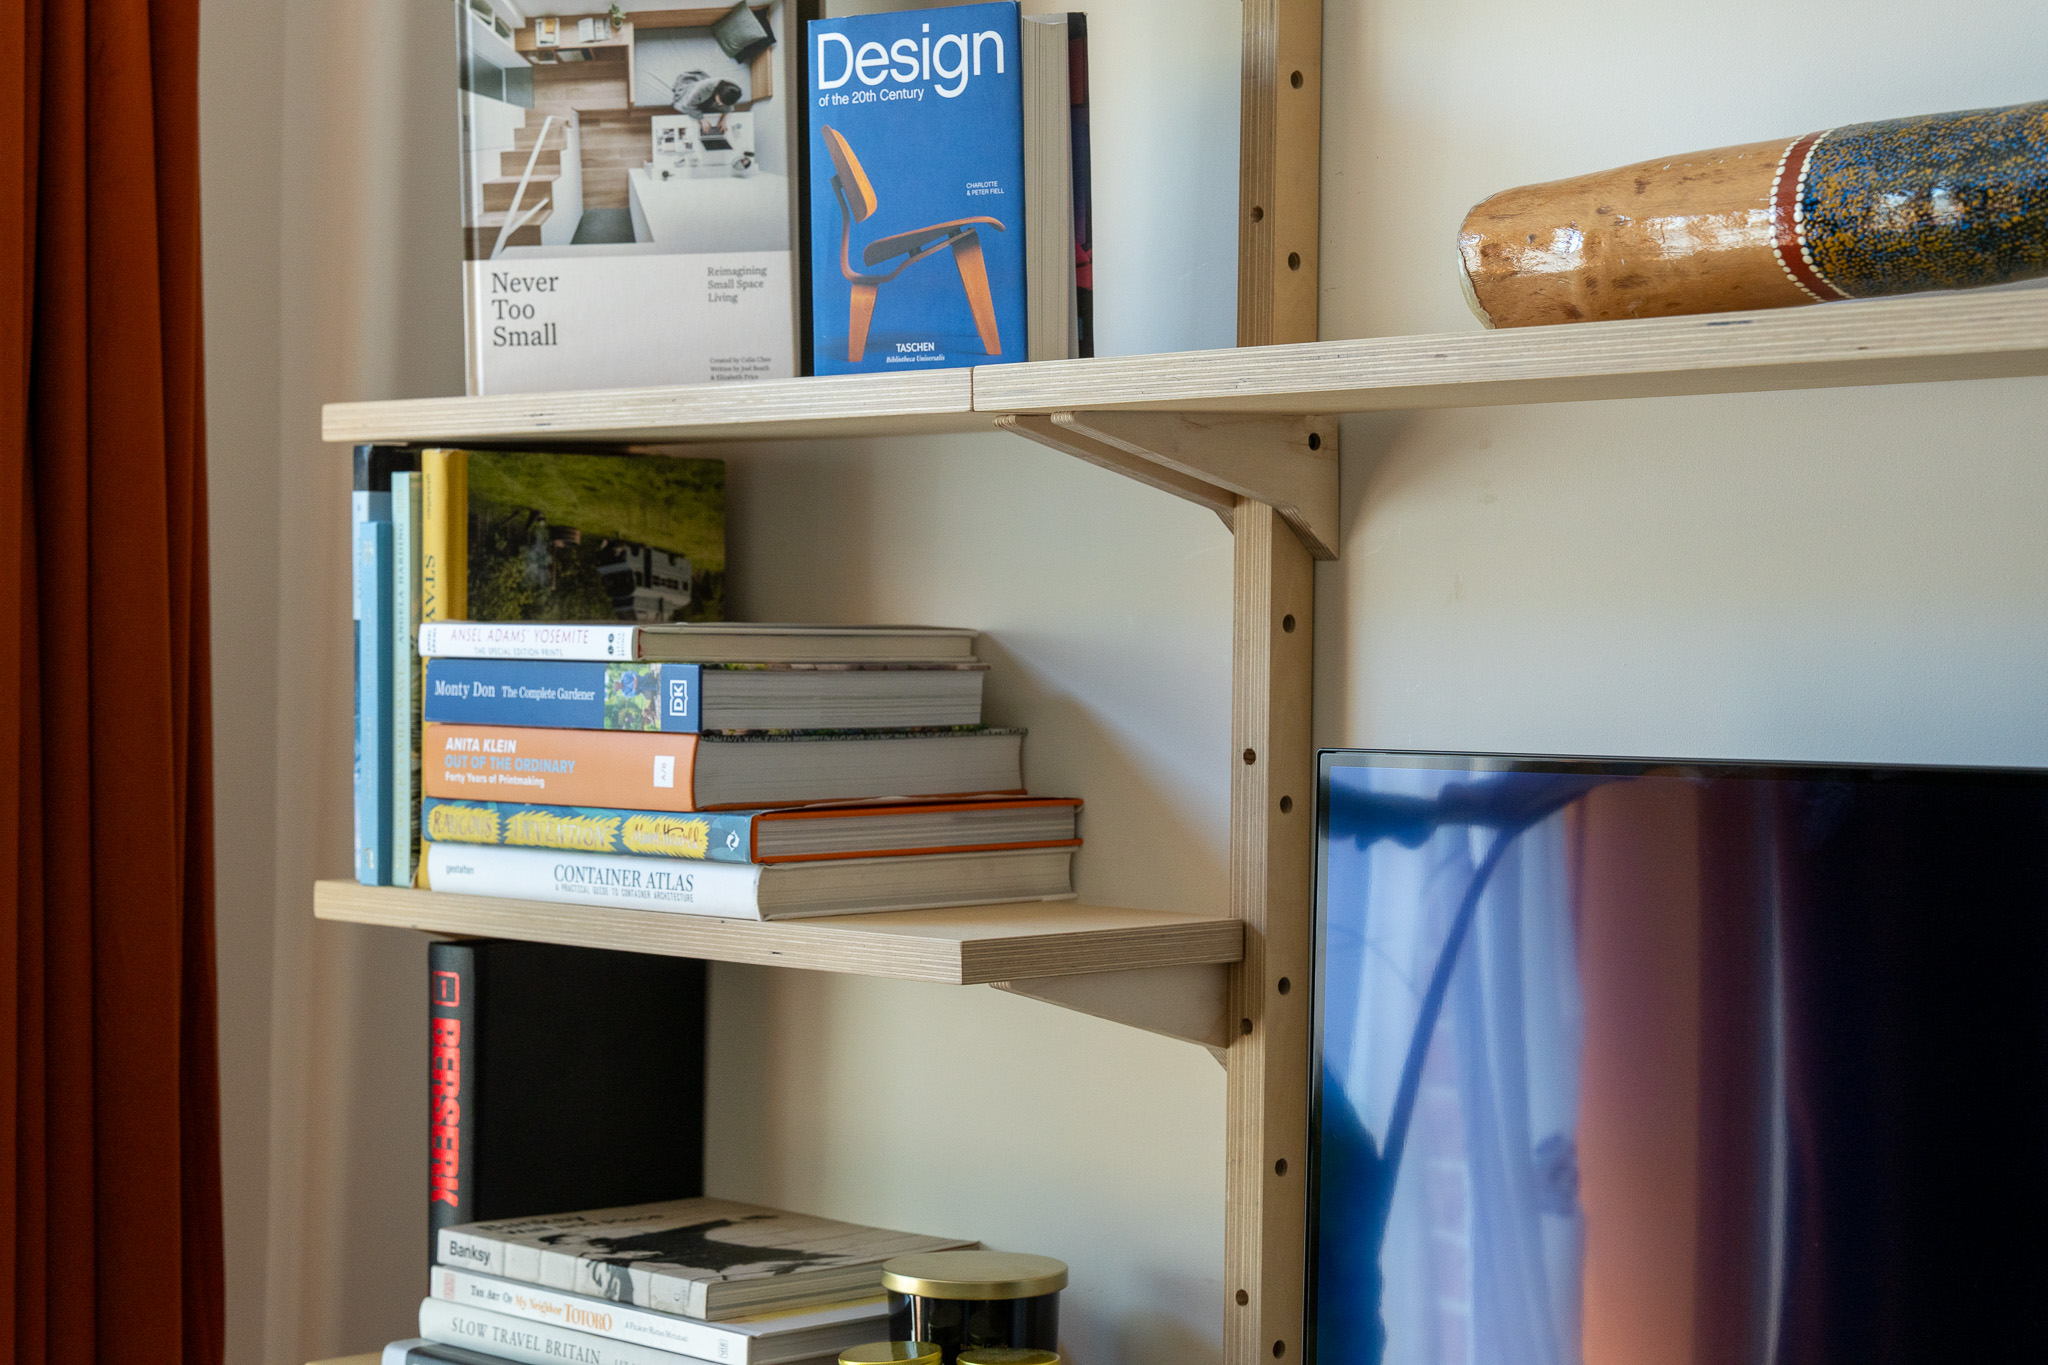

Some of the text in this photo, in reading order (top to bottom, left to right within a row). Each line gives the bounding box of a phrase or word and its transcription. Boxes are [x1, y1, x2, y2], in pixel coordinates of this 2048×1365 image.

[817, 23, 1005, 98] Design
[818, 87, 925, 107] of the 20th Century
[966, 180, 998, 189] CHARLOTTE
[990, 187, 1004, 195] FIELL
[707, 266, 767, 277] Reimagining
[491, 272, 559, 293] Never
[707, 279, 765, 291] Small Space
[708, 292, 739, 304] Living
[492, 299, 535, 321] Too
[492, 323, 558, 348] Small
[896, 342, 935, 353] TASCHEN
[450, 629, 482, 642] ANSEL
[534, 629, 589, 644] YOSEMITE
[474, 647, 563, 657] THE SPECIAL EDITION PRINTS
[434, 680, 496, 699] Monty Don
[502, 685, 595, 702] The Complete Gardener
[673, 684, 684, 711] DK
[445, 737, 517, 753] ANITA KLEIN
[444, 754, 576, 774] OUT OF THE ORDINARY
[445, 771, 545, 789] Forty Years of Printmaking
[432, 809, 609, 849] RAUCOUS INVENTION
[628, 823, 660, 845] Mark
[446, 864, 475, 876] gestalten
[554, 864, 694, 892] CONTAINER ATLAS
[561, 884, 590, 895] PRACTICAL
[593, 886, 609, 896] GUIDE
[611, 888, 619, 897] TO
[621, 889, 651, 899] CONTAINER
[653, 890, 694, 903] ARCHITECTURE
[430, 1018, 460, 1208] BERSERK
[449, 1240, 491, 1266] Banksy
[515, 1294, 527, 1311] My
[529, 1298, 562, 1316] Neighbor
[564, 1303, 612, 1333] TOTORO
[451, 1316, 601, 1364] SLOW TRAVEL BRITAIN
